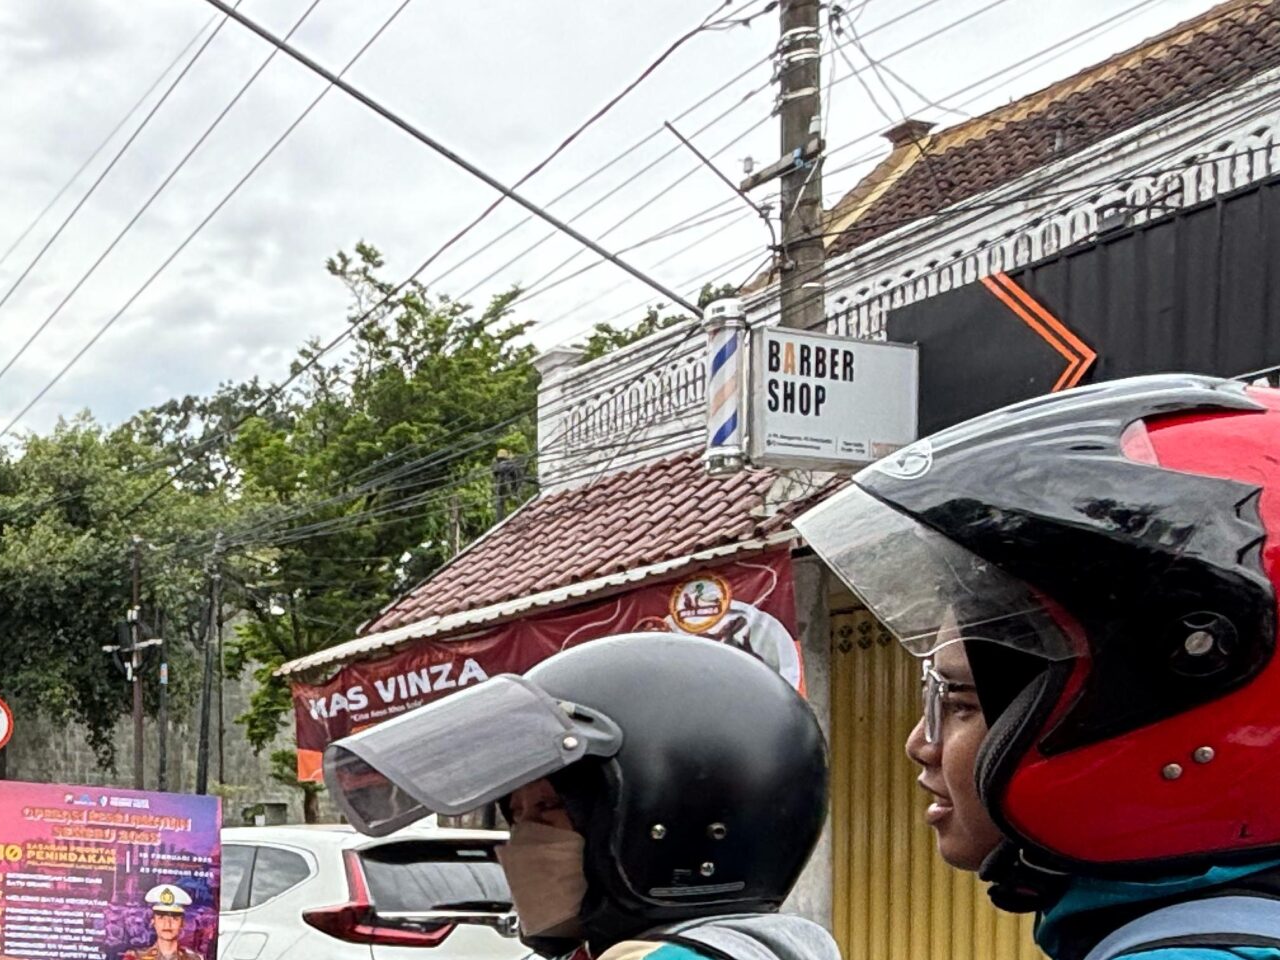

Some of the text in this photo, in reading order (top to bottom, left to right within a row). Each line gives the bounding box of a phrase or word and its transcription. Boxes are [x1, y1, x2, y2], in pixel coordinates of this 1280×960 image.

[768, 340, 854, 382] BARBER
[767, 379, 826, 416] SHOP
[374, 658, 489, 704] VINZA
[26, 849, 117, 865] PENINDAKAN
